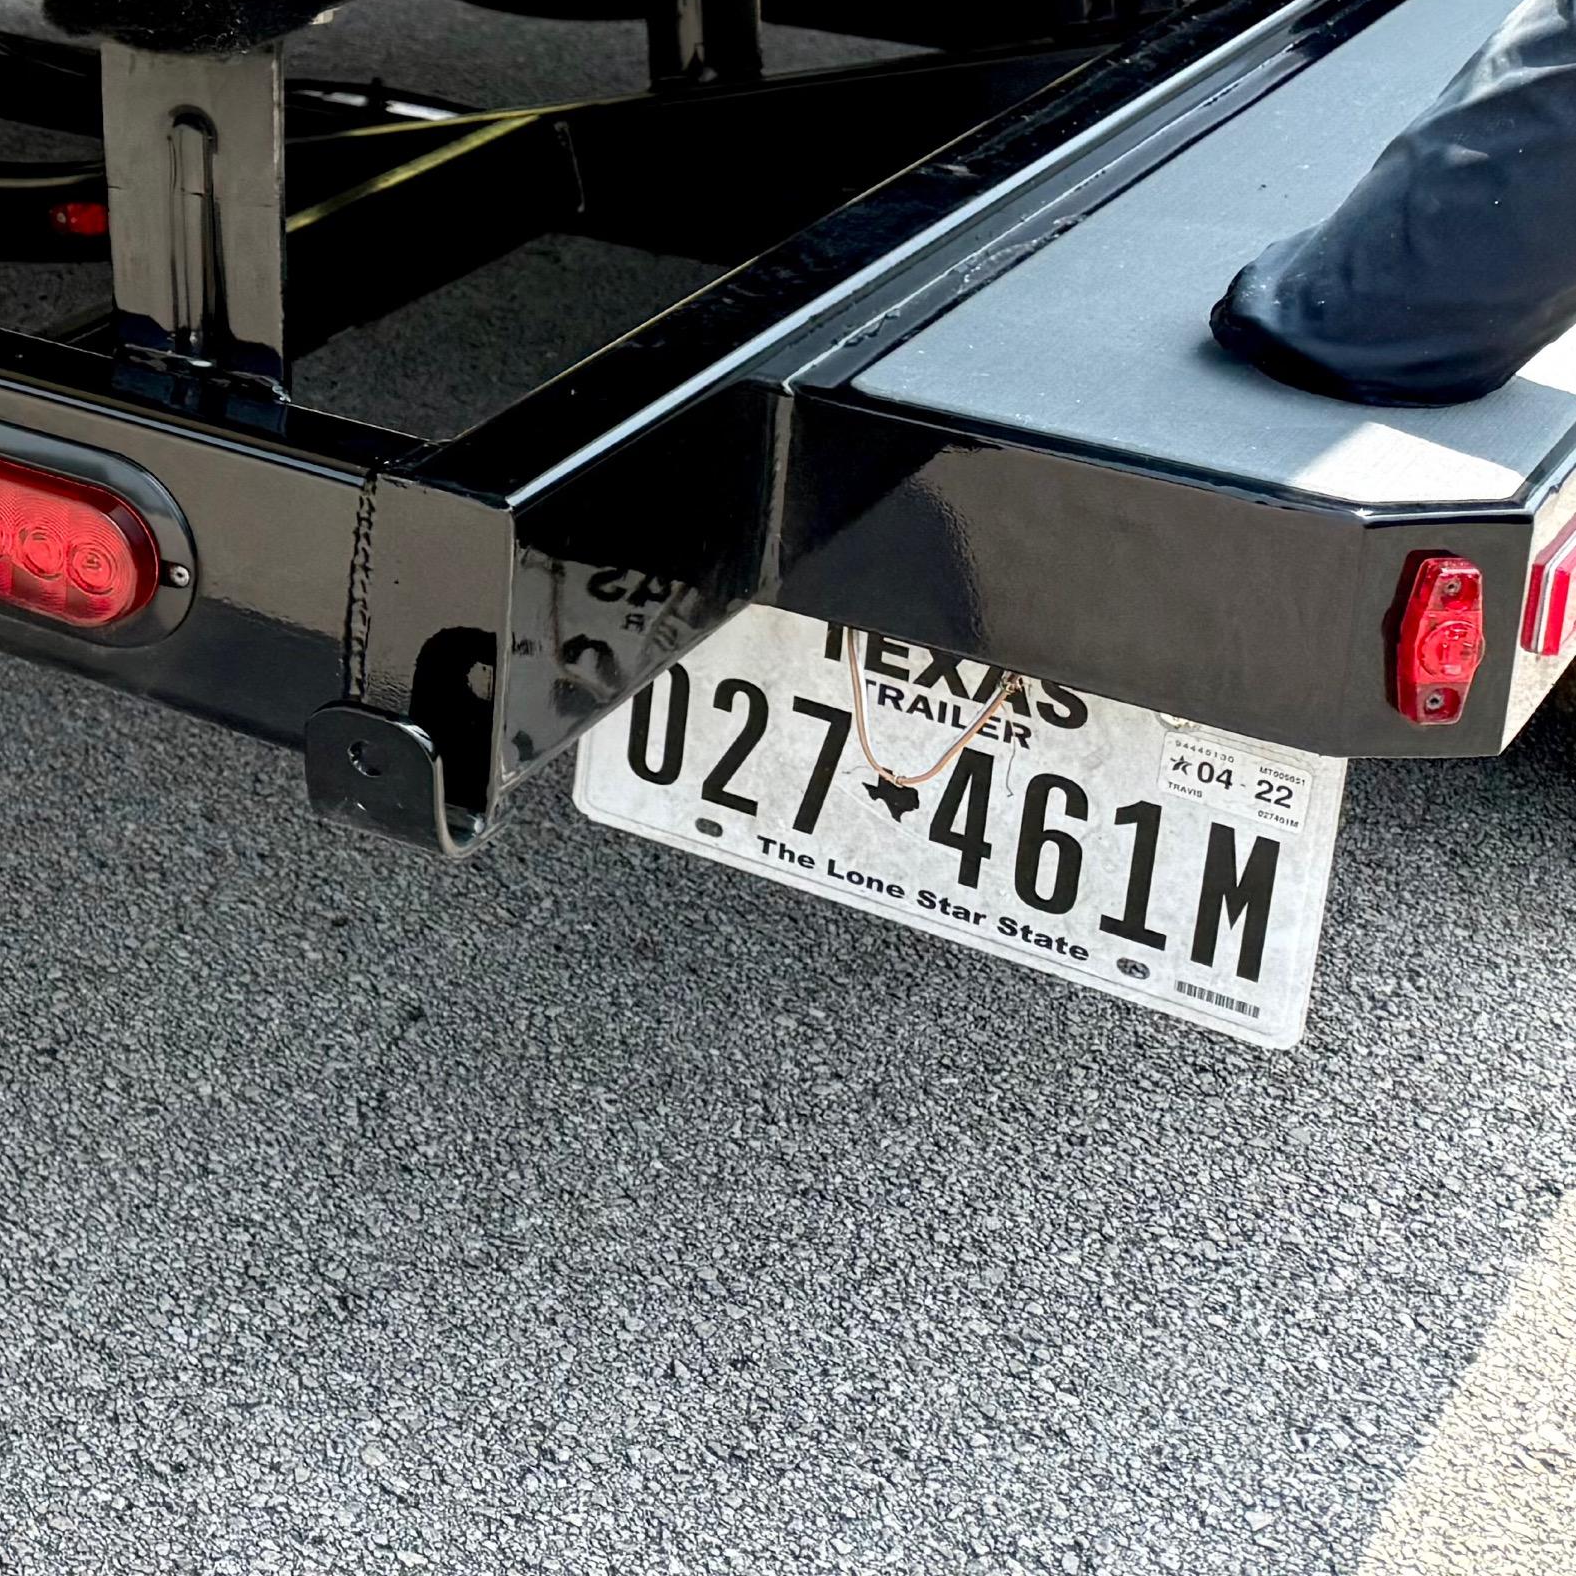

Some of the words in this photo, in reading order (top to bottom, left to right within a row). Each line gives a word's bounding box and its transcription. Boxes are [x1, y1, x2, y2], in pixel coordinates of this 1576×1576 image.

[628, 662, 852, 835] 027
[929, 747, 1280, 983] 461M
[1167, 781, 1203, 799] TRAVIS
[757, 834, 816, 870] The
[827, 858, 905, 899] Lone
[916, 889, 987, 927] Star
[997, 915, 1090, 962] State
